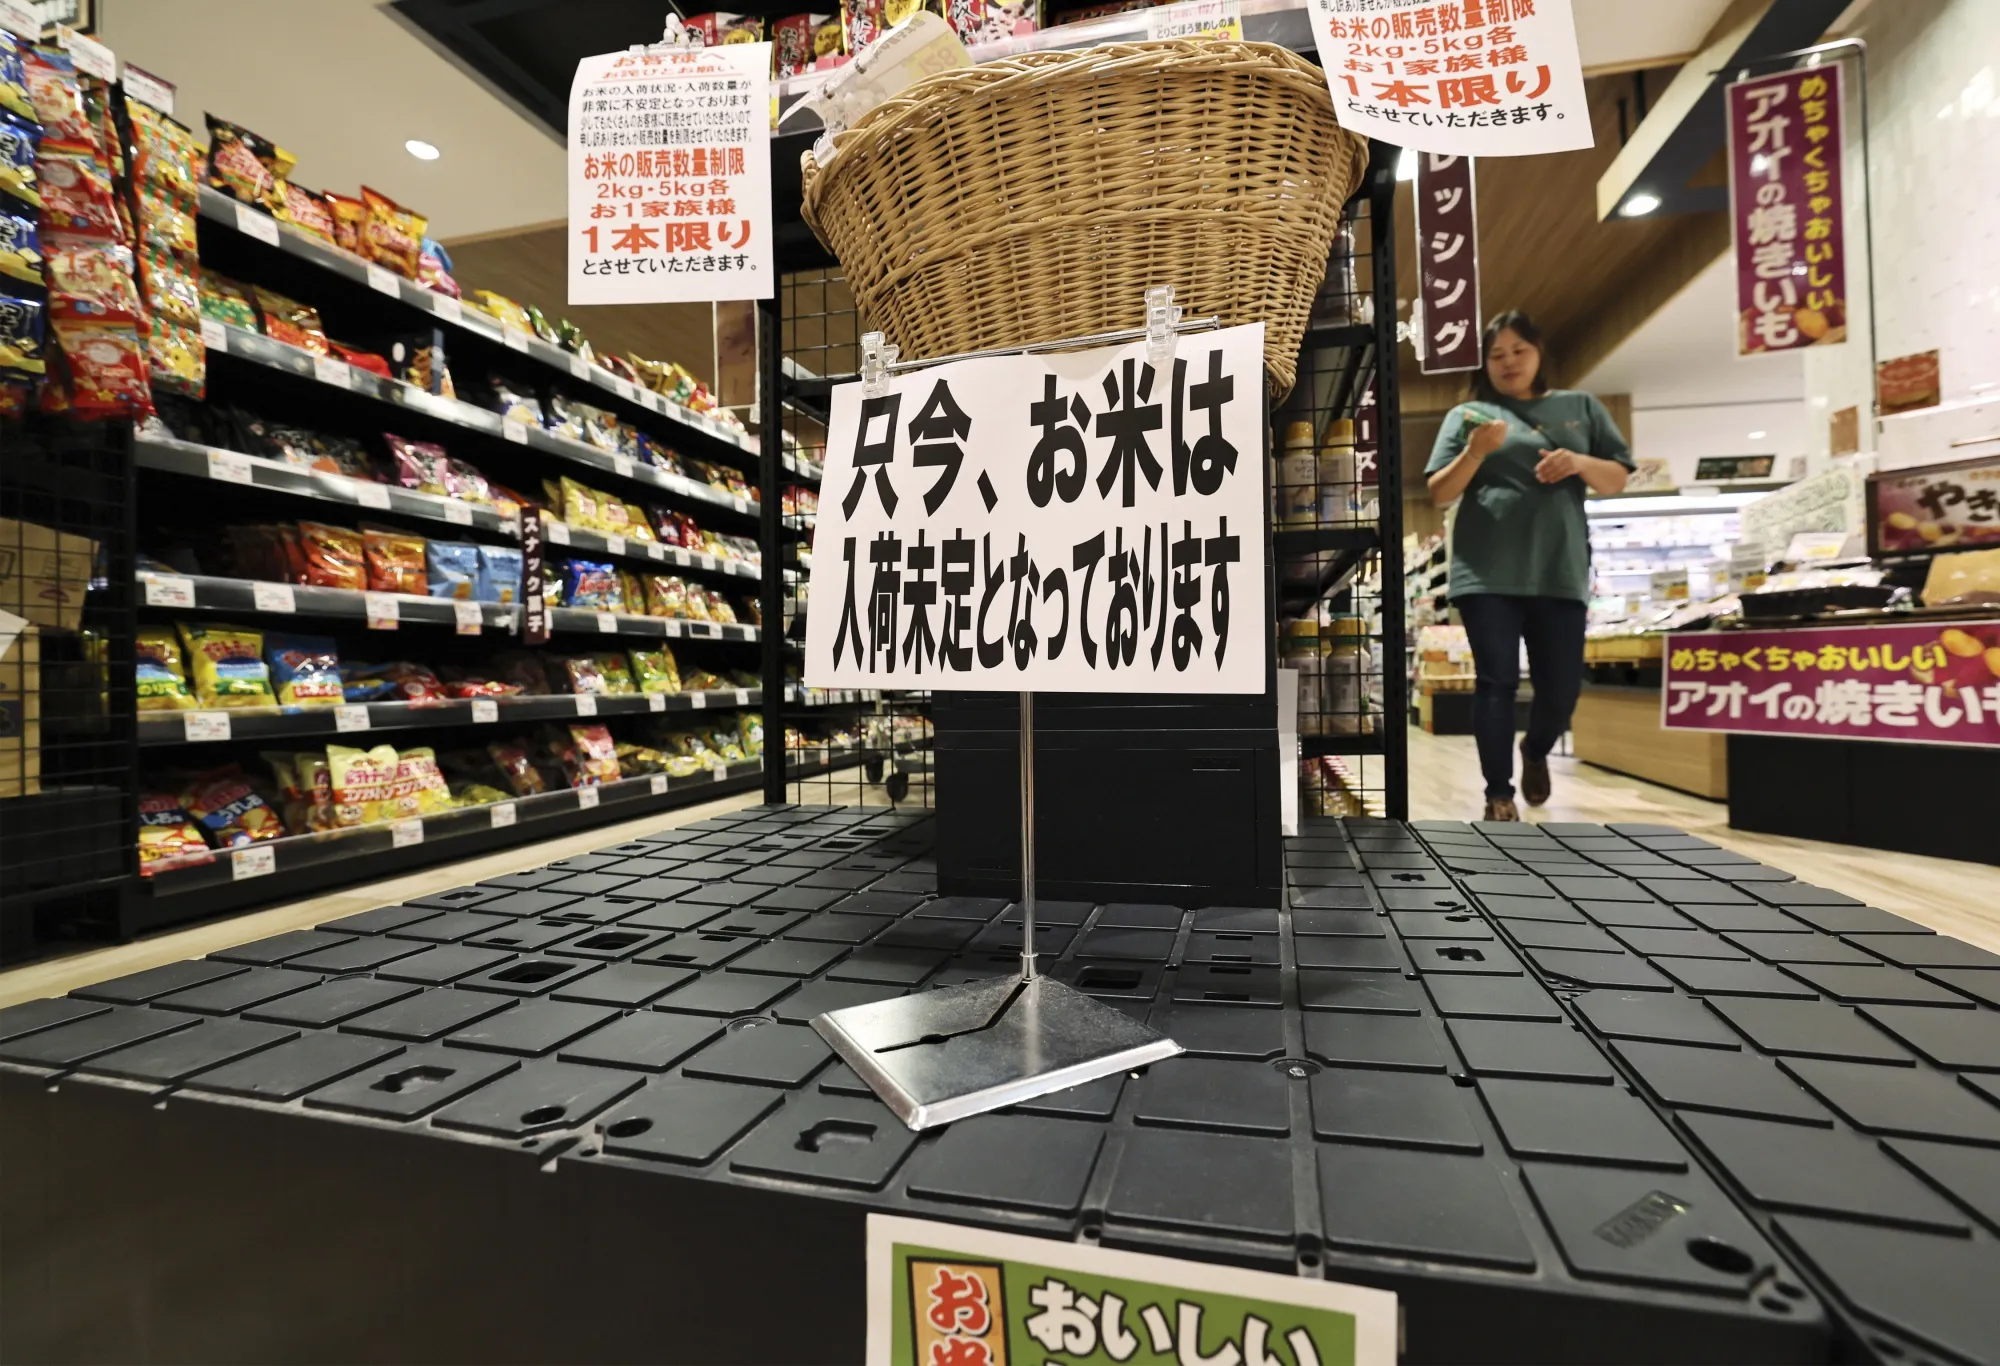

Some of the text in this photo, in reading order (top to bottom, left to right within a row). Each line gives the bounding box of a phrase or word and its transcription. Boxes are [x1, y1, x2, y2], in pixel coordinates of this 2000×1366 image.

[1329, 0, 1536, 41] お米の販売数量制限
[1343, 45, 1529, 76] お1家族様
[581, 94, 752, 113] 非常に不安定となっております
[582, 80, 752, 98] お米の入荷状況・入荷数量が
[1338, 64, 1552, 109] 1本限り
[1347, 98, 1565, 128] とさせていただきます。
[584, 147, 745, 181] お米の販売数量制限
[590, 198, 736, 219] お1家族様
[1799, 75, 1836, 311] めちゃくちゃおいしい
[1745, 84, 1798, 347] アオイの焼きいも
[581, 219, 751, 255] 1本限り
[582, 253, 757, 276] とさせていただきます。
[841, 349, 1239, 523] 只今、お米は
[1916, 479, 2000, 522] やき
[832, 516, 1241, 674] 入荷未定となっております
[1671, 644, 1948, 672] めちゃくちゃおいしい
[1027, 1277, 1321, 1366] おいしい
